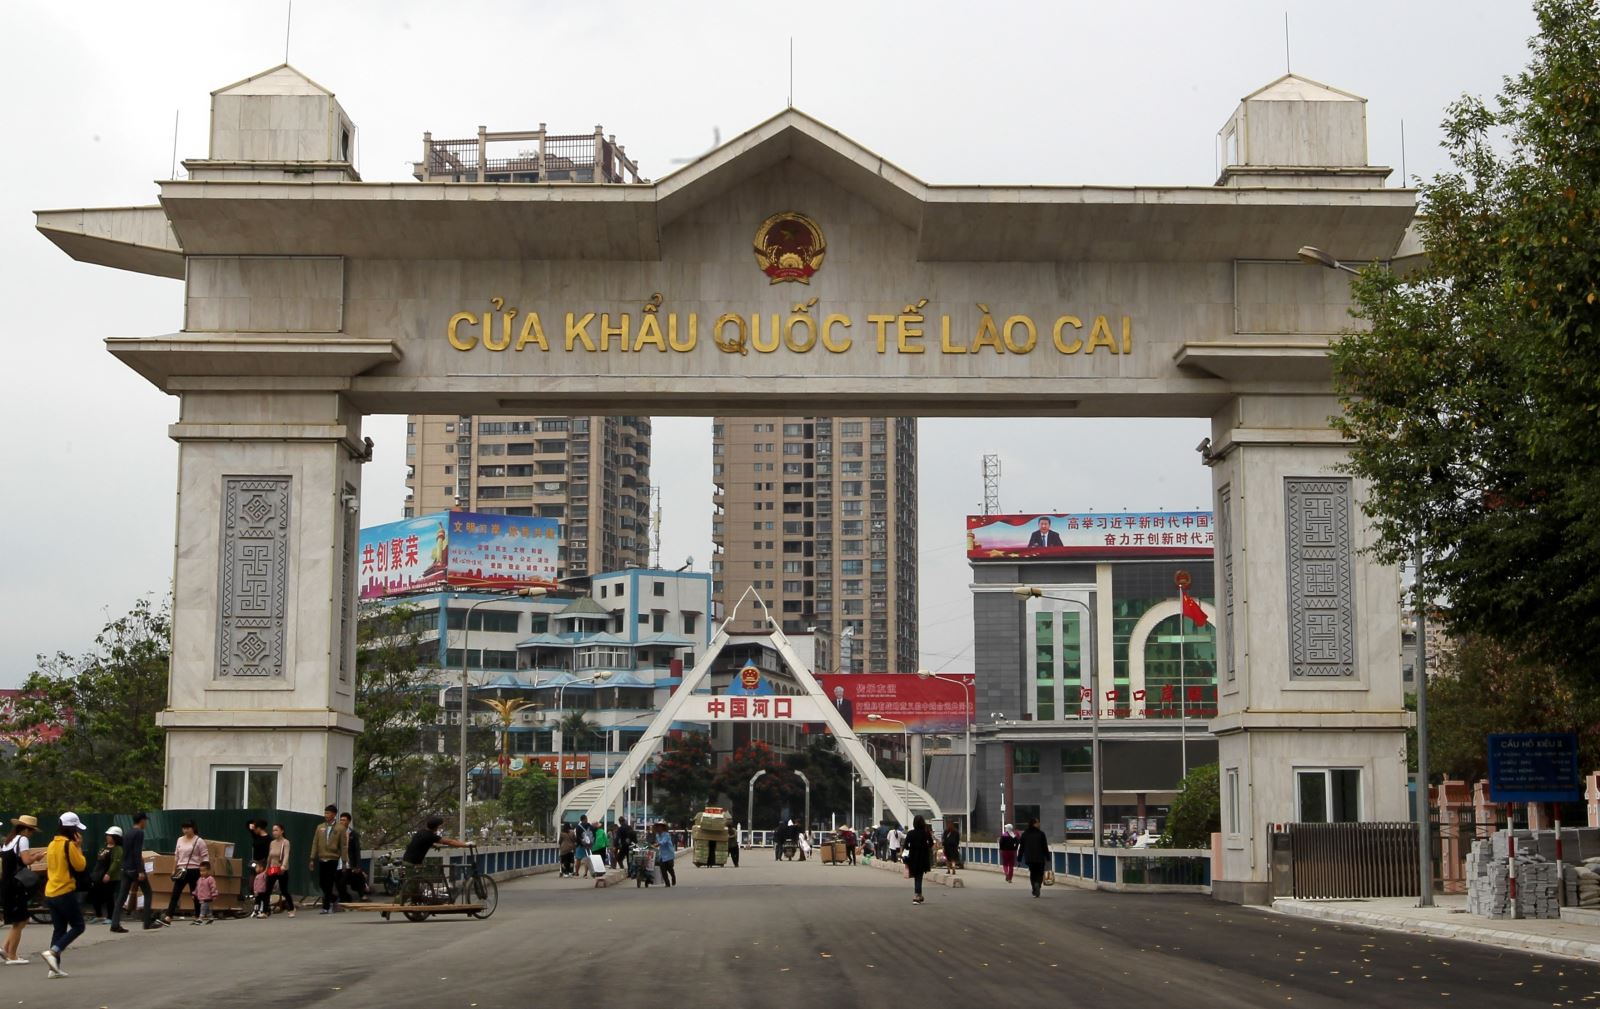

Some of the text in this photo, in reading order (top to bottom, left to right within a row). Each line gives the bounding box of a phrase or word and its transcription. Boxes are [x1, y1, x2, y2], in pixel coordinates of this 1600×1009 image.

[446, 292, 1132, 355] CỬA KHẨU QUỐC TẾ LÀO CAI
[362, 535, 419, 575] 共创繁荣
[707, 697, 793, 719] 中国河口
